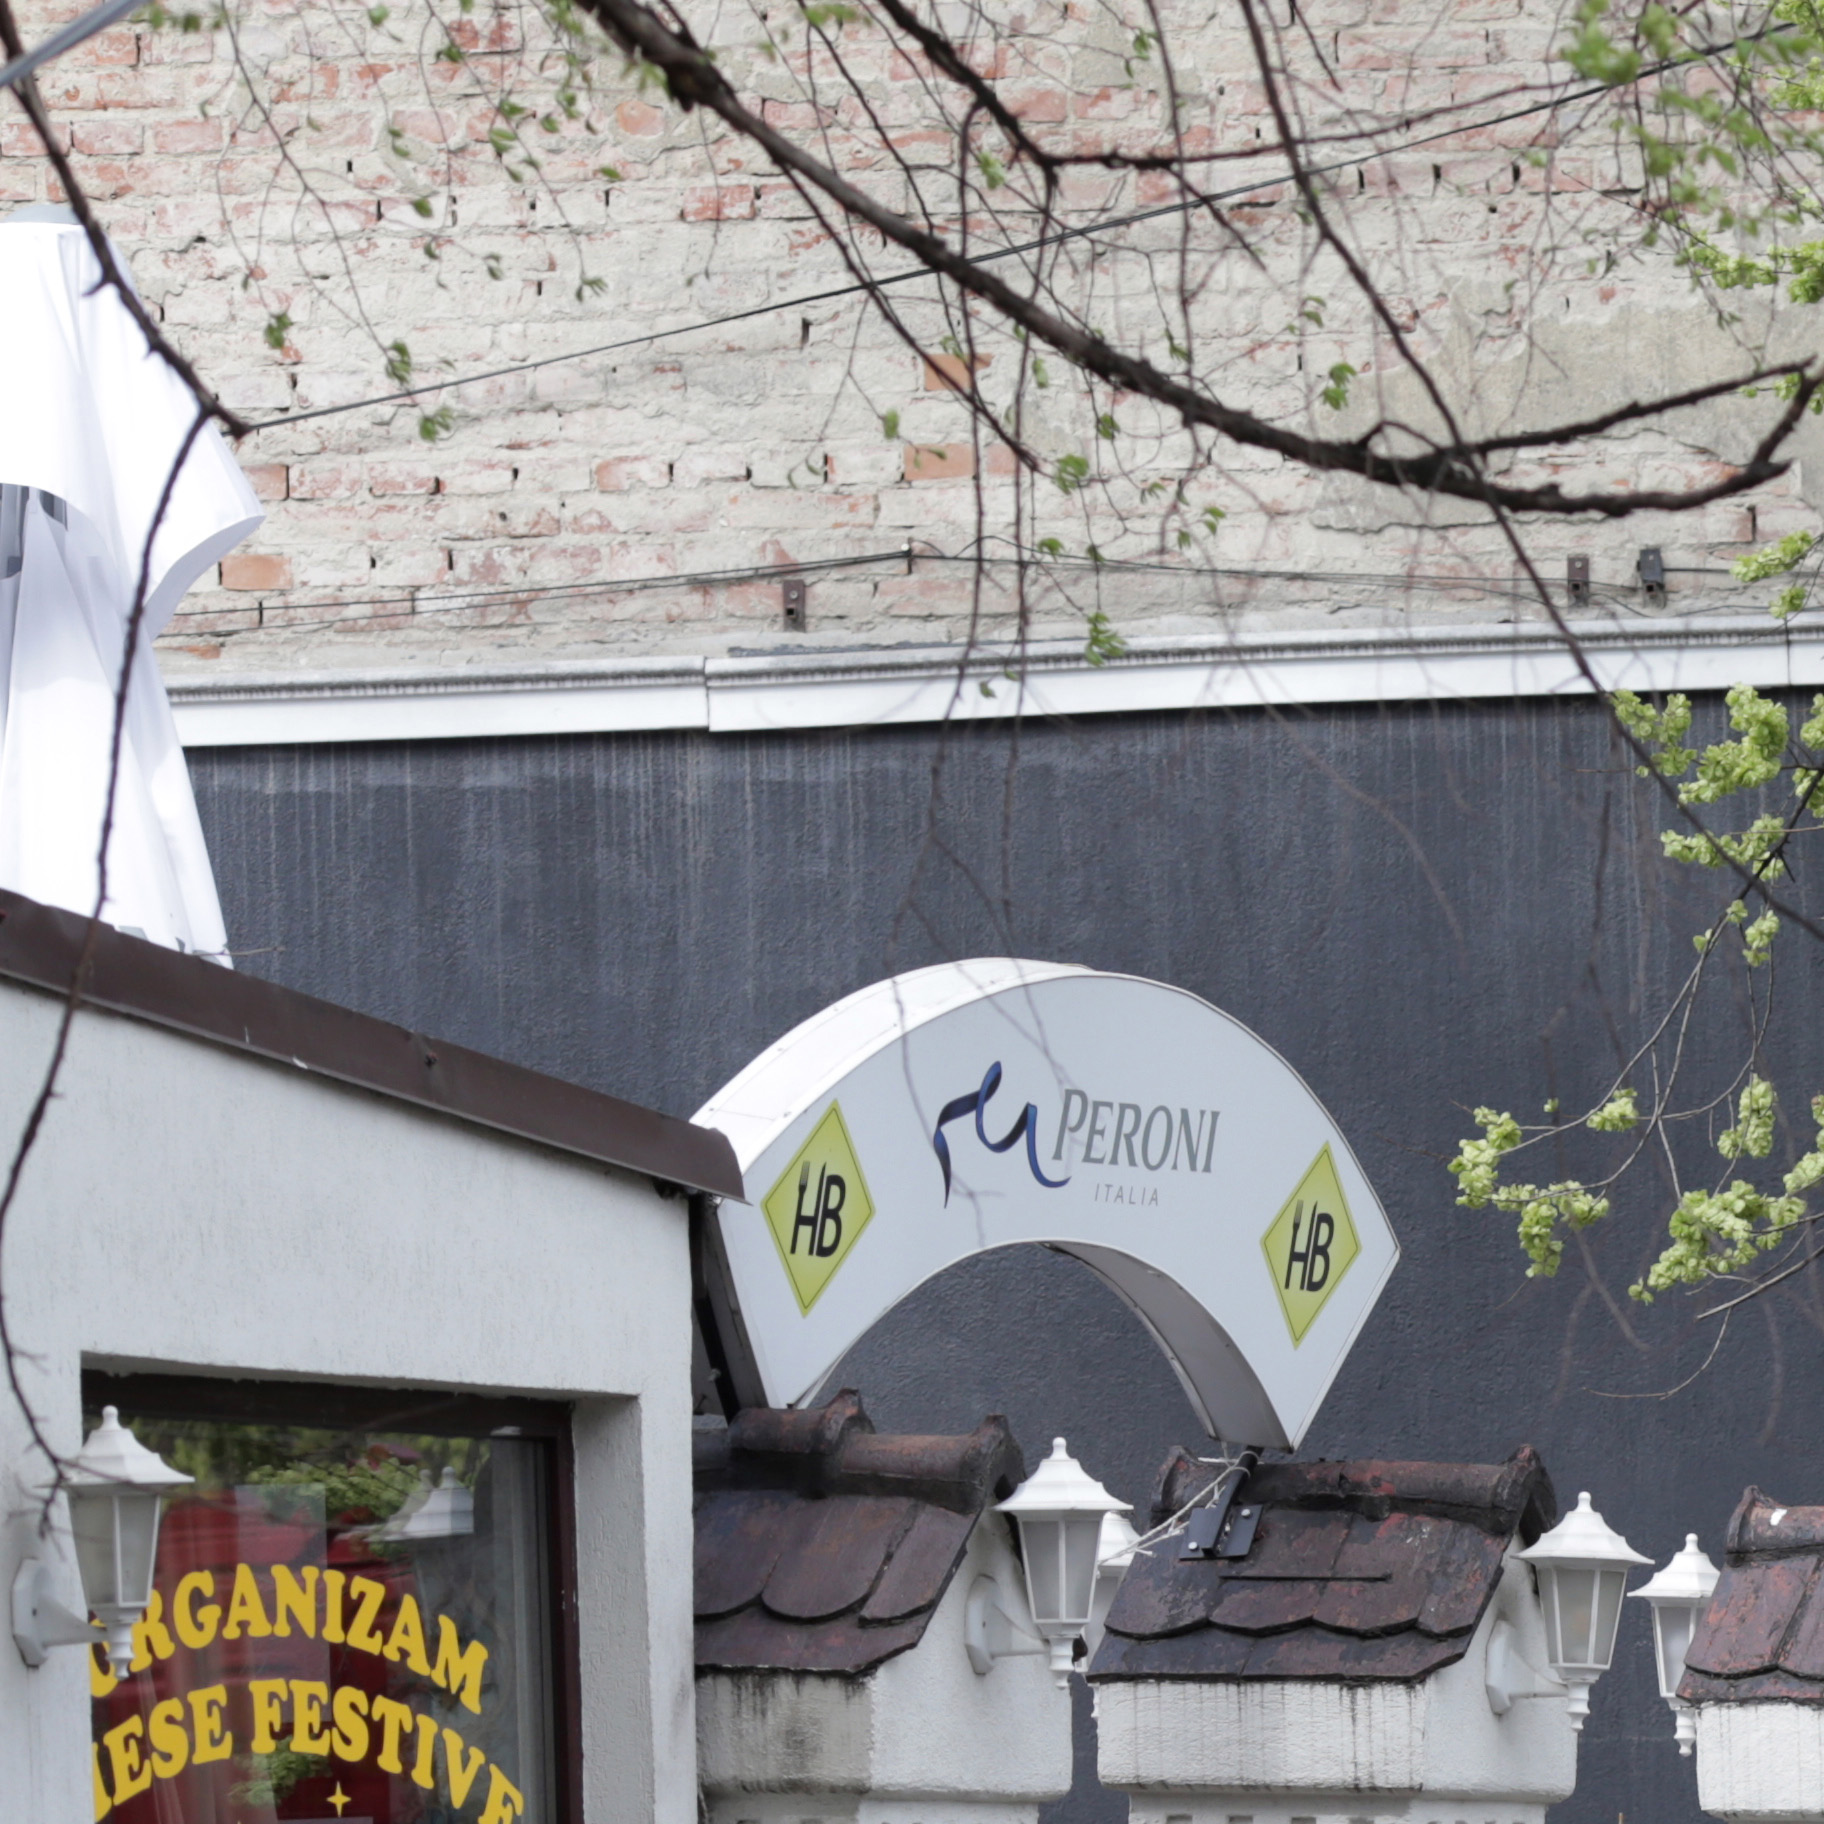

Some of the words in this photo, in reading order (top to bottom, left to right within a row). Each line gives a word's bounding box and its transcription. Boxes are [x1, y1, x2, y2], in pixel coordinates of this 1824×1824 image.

[1051, 1089, 1221, 1173] PERONI
[790, 1161, 847, 1258] HB
[1095, 1183, 1160, 1207] ITALIA
[1284, 1200, 1335, 1293] HB
